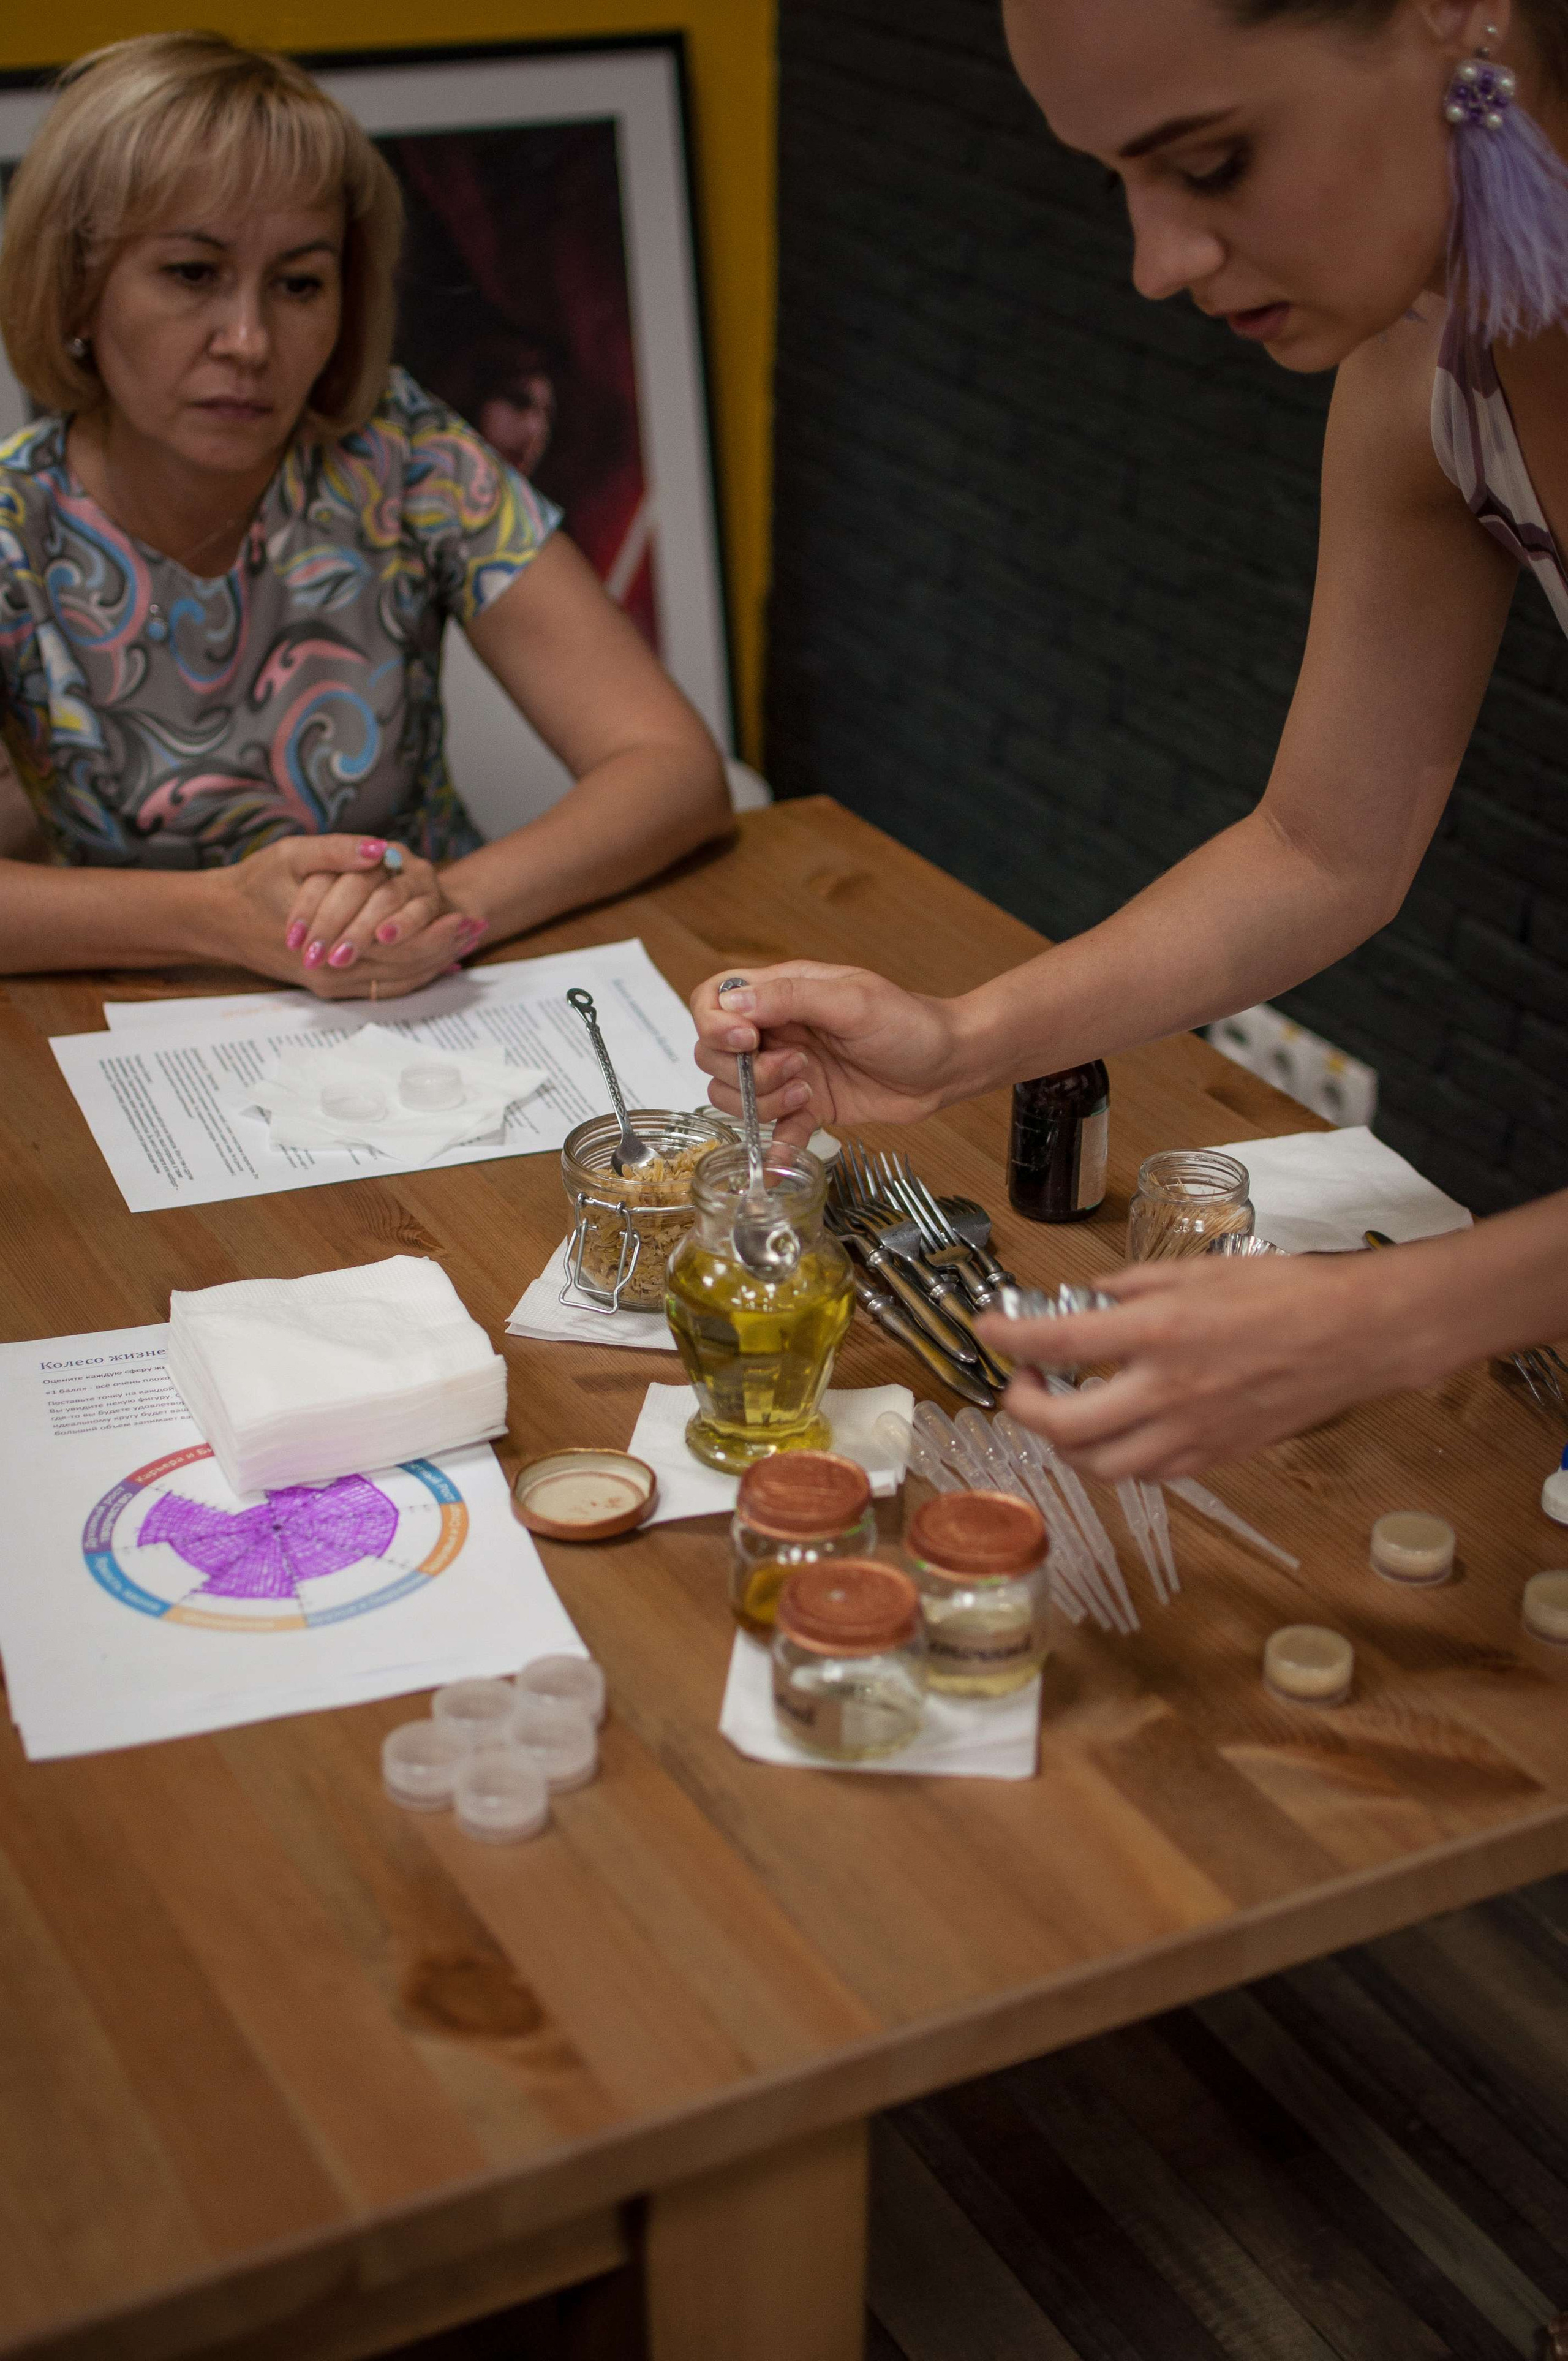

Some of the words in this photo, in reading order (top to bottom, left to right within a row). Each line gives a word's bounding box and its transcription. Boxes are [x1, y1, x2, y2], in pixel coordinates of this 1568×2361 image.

[40, 1358, 104, 1370] Колесо
[109, 1349, 166, 1361] жизне
[86, 1371, 123, 1380] каждую
[48, 1397, 95, 1406] Поставьте
[66, 1403, 104, 1412] увидите
[53, 1418, 111, 1428] идеальному
[54, 1427, 97, 1436] больший
[134, 1417, 177, 1426] занимает
